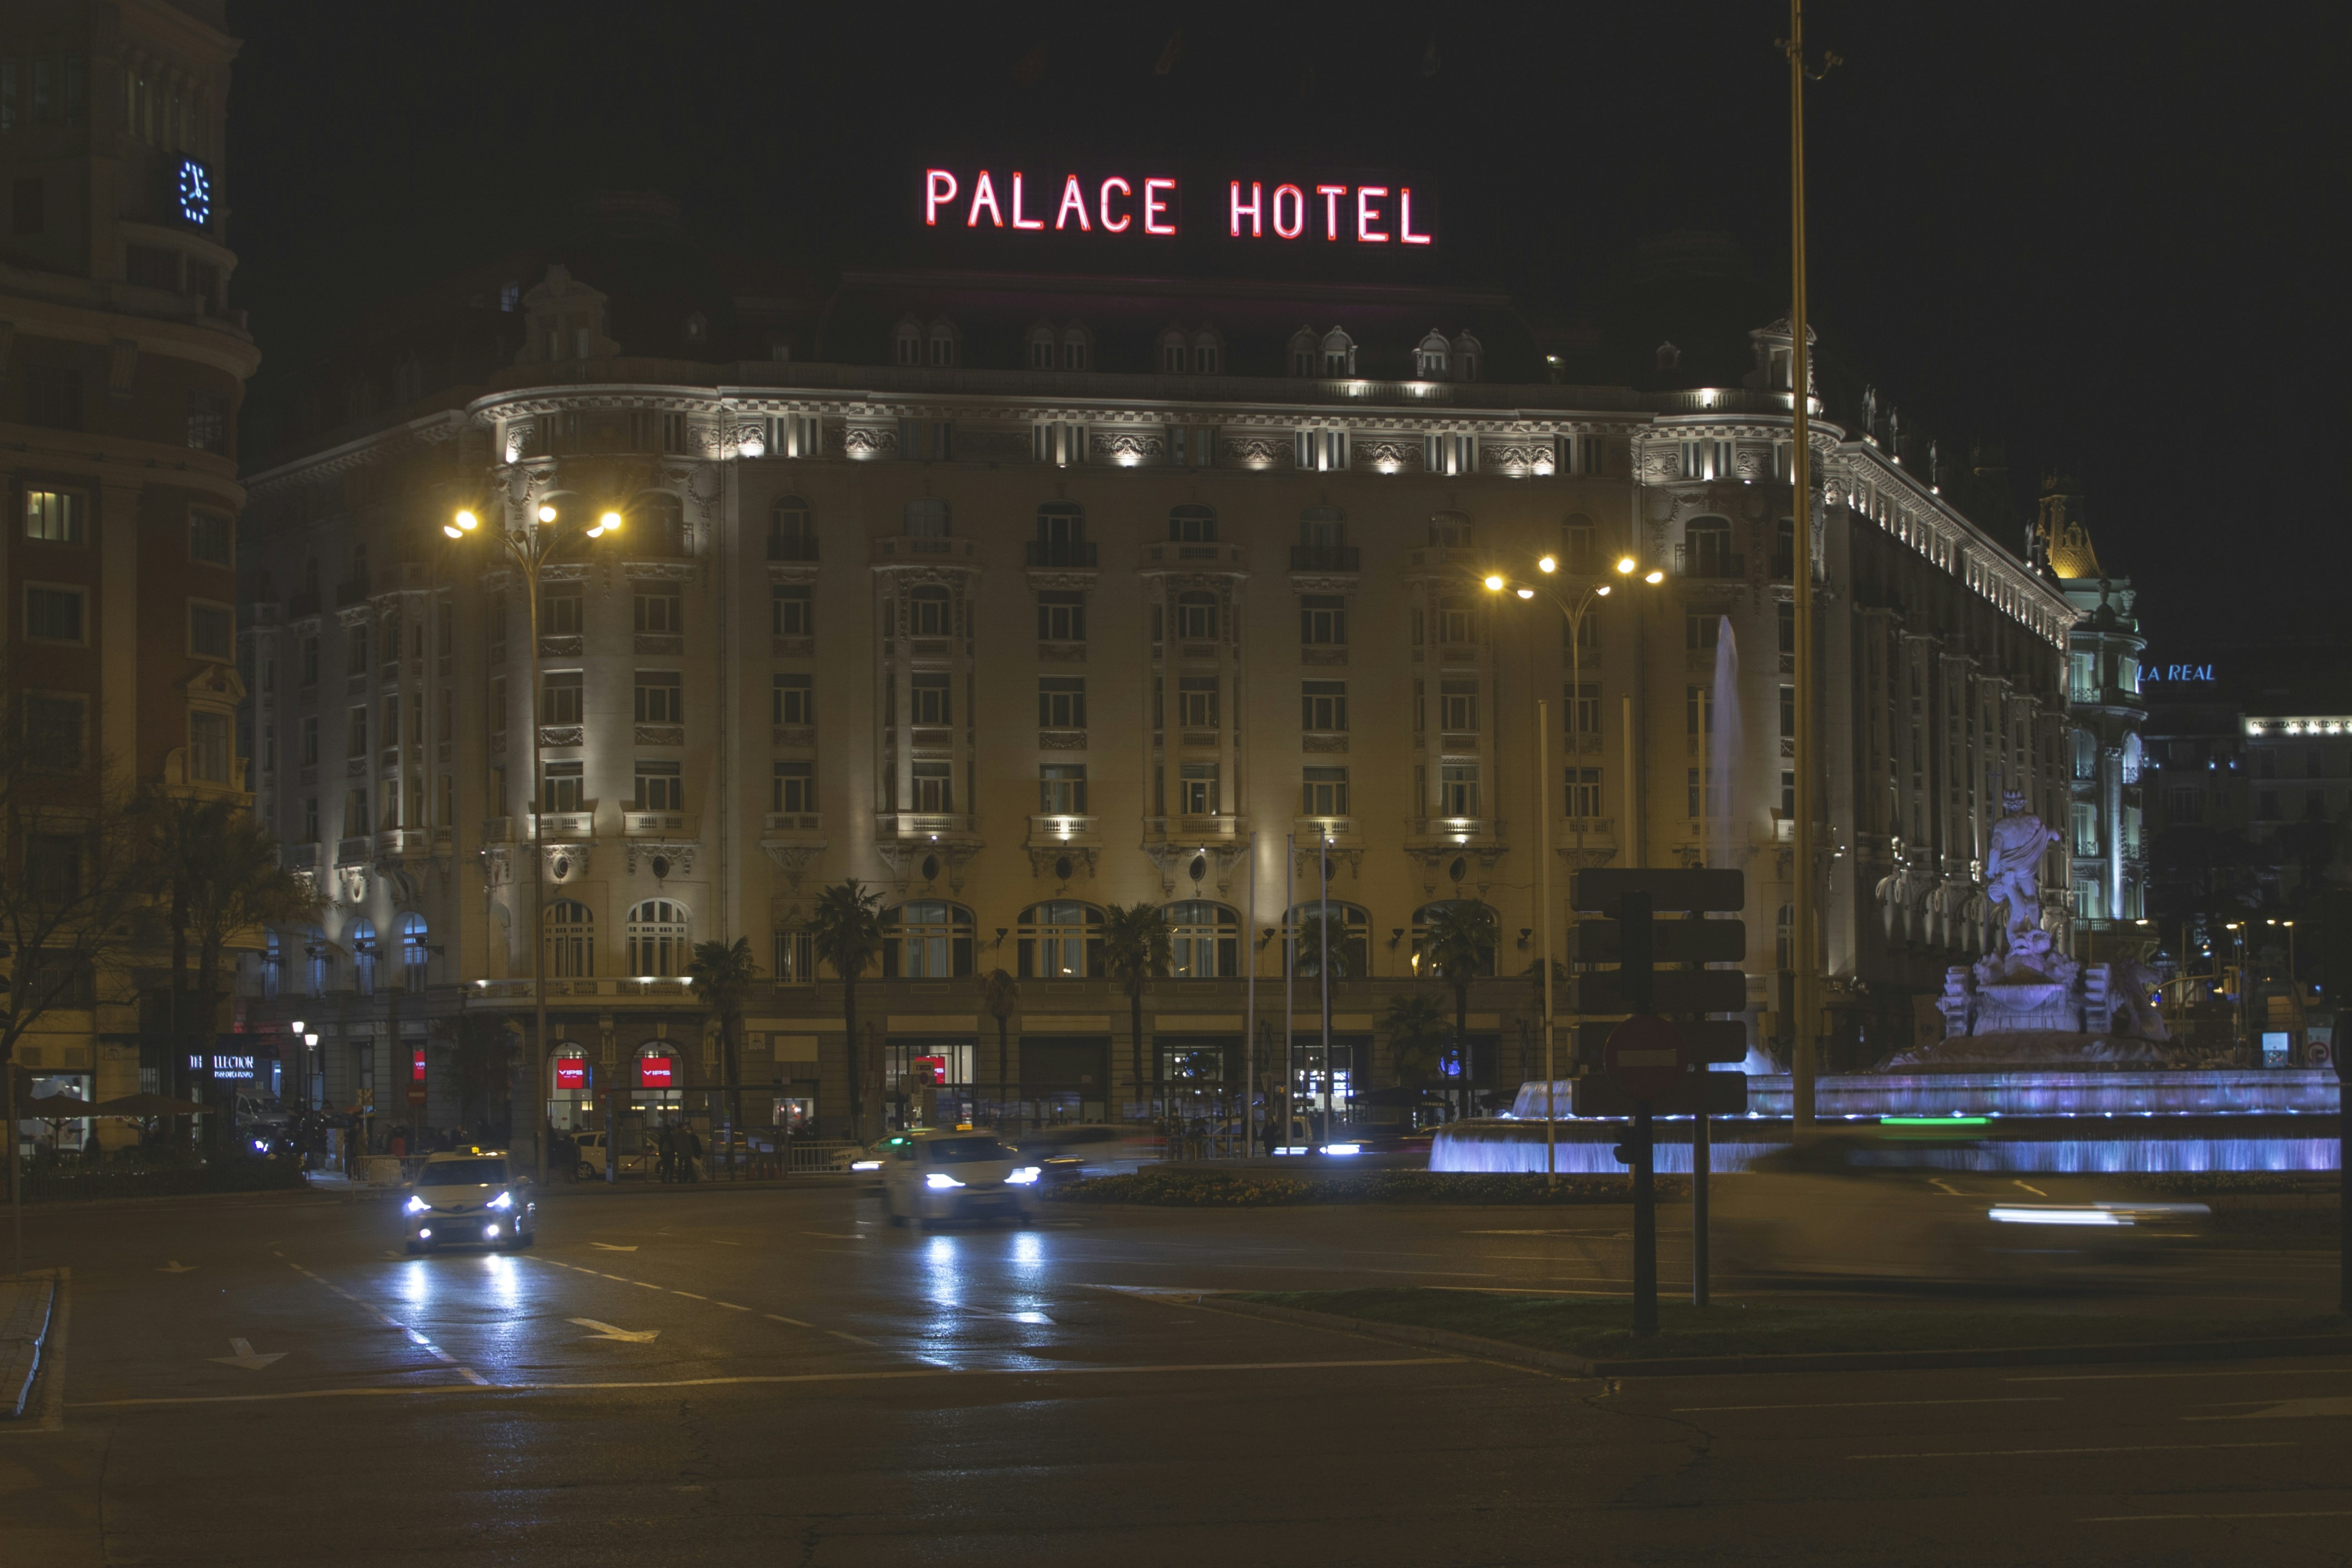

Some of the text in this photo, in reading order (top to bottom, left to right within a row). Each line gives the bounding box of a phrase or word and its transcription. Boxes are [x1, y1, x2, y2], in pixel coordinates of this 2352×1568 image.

[926, 168, 1431, 244] PALACE HOTEL
[2168, 663, 2215, 681] REAL
[214, 1055, 254, 1069] LLECTION
